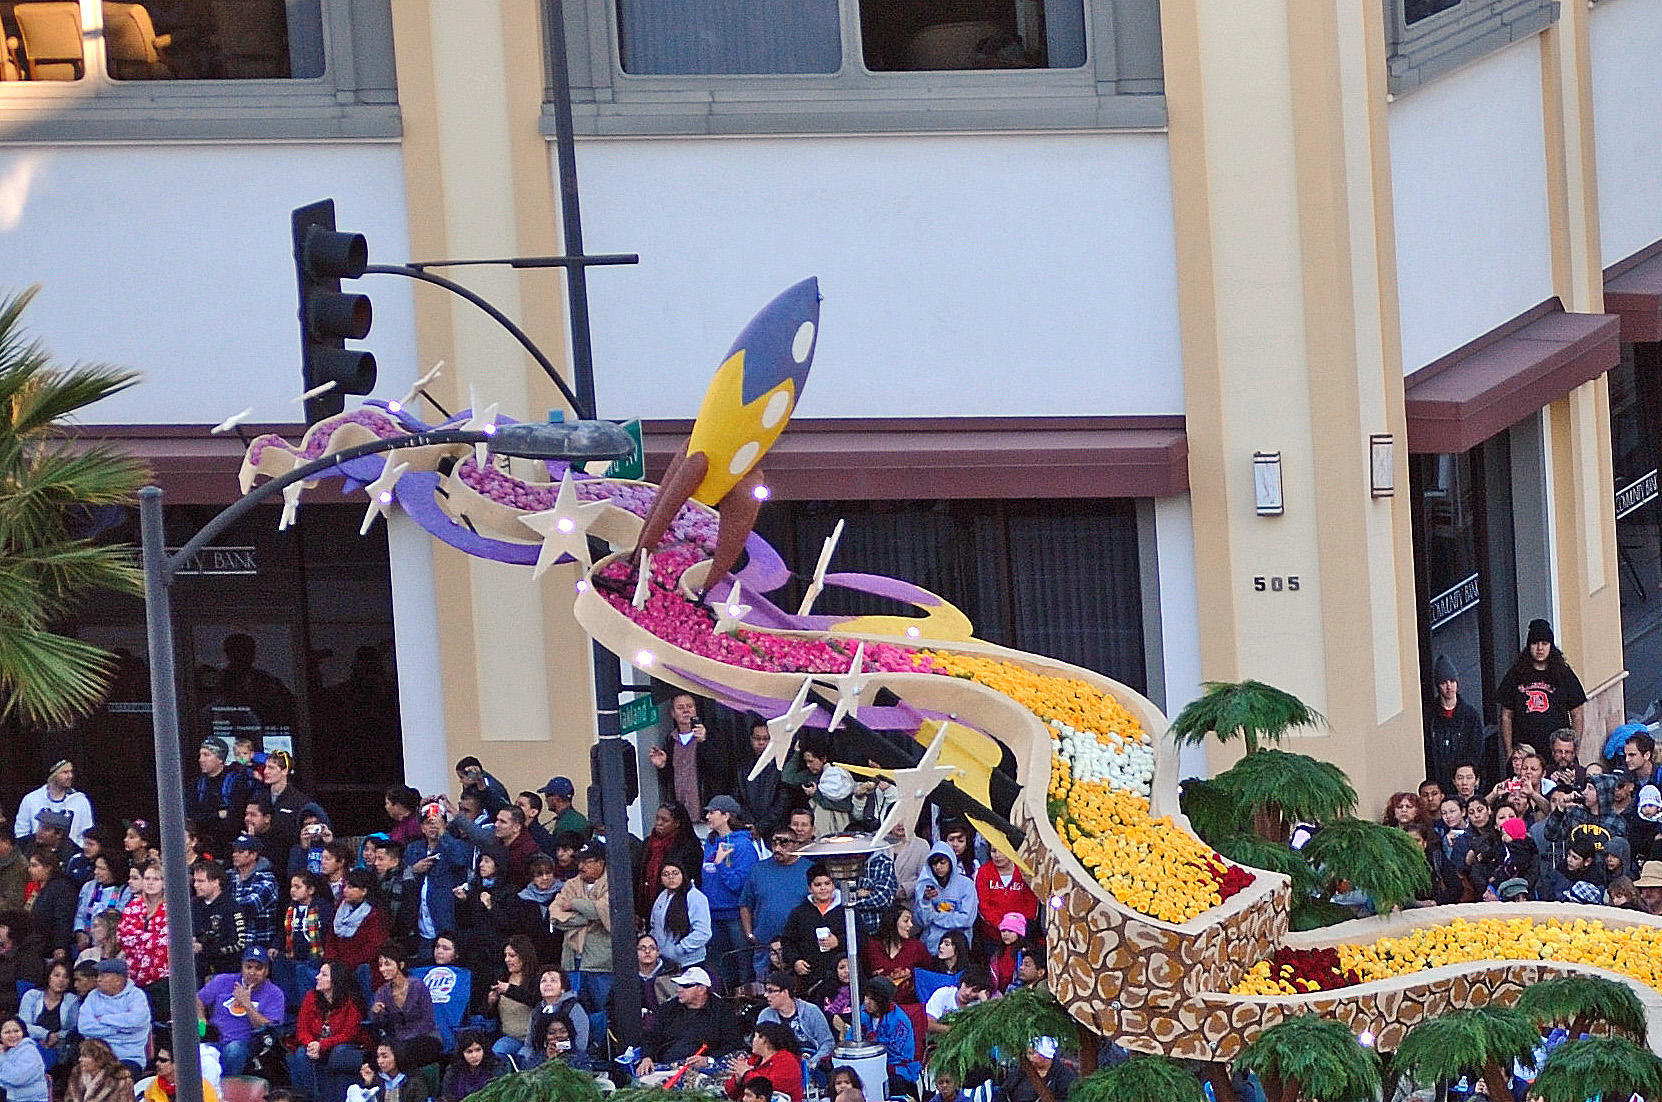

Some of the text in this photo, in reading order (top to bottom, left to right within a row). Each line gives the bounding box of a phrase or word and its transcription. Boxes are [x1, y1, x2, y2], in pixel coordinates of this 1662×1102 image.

[1645, 474, 1659, 497] BANK
[214, 551, 257, 568] BANK
[1253, 576, 1300, 591] 505
[1464, 579, 1480, 604] BANK
